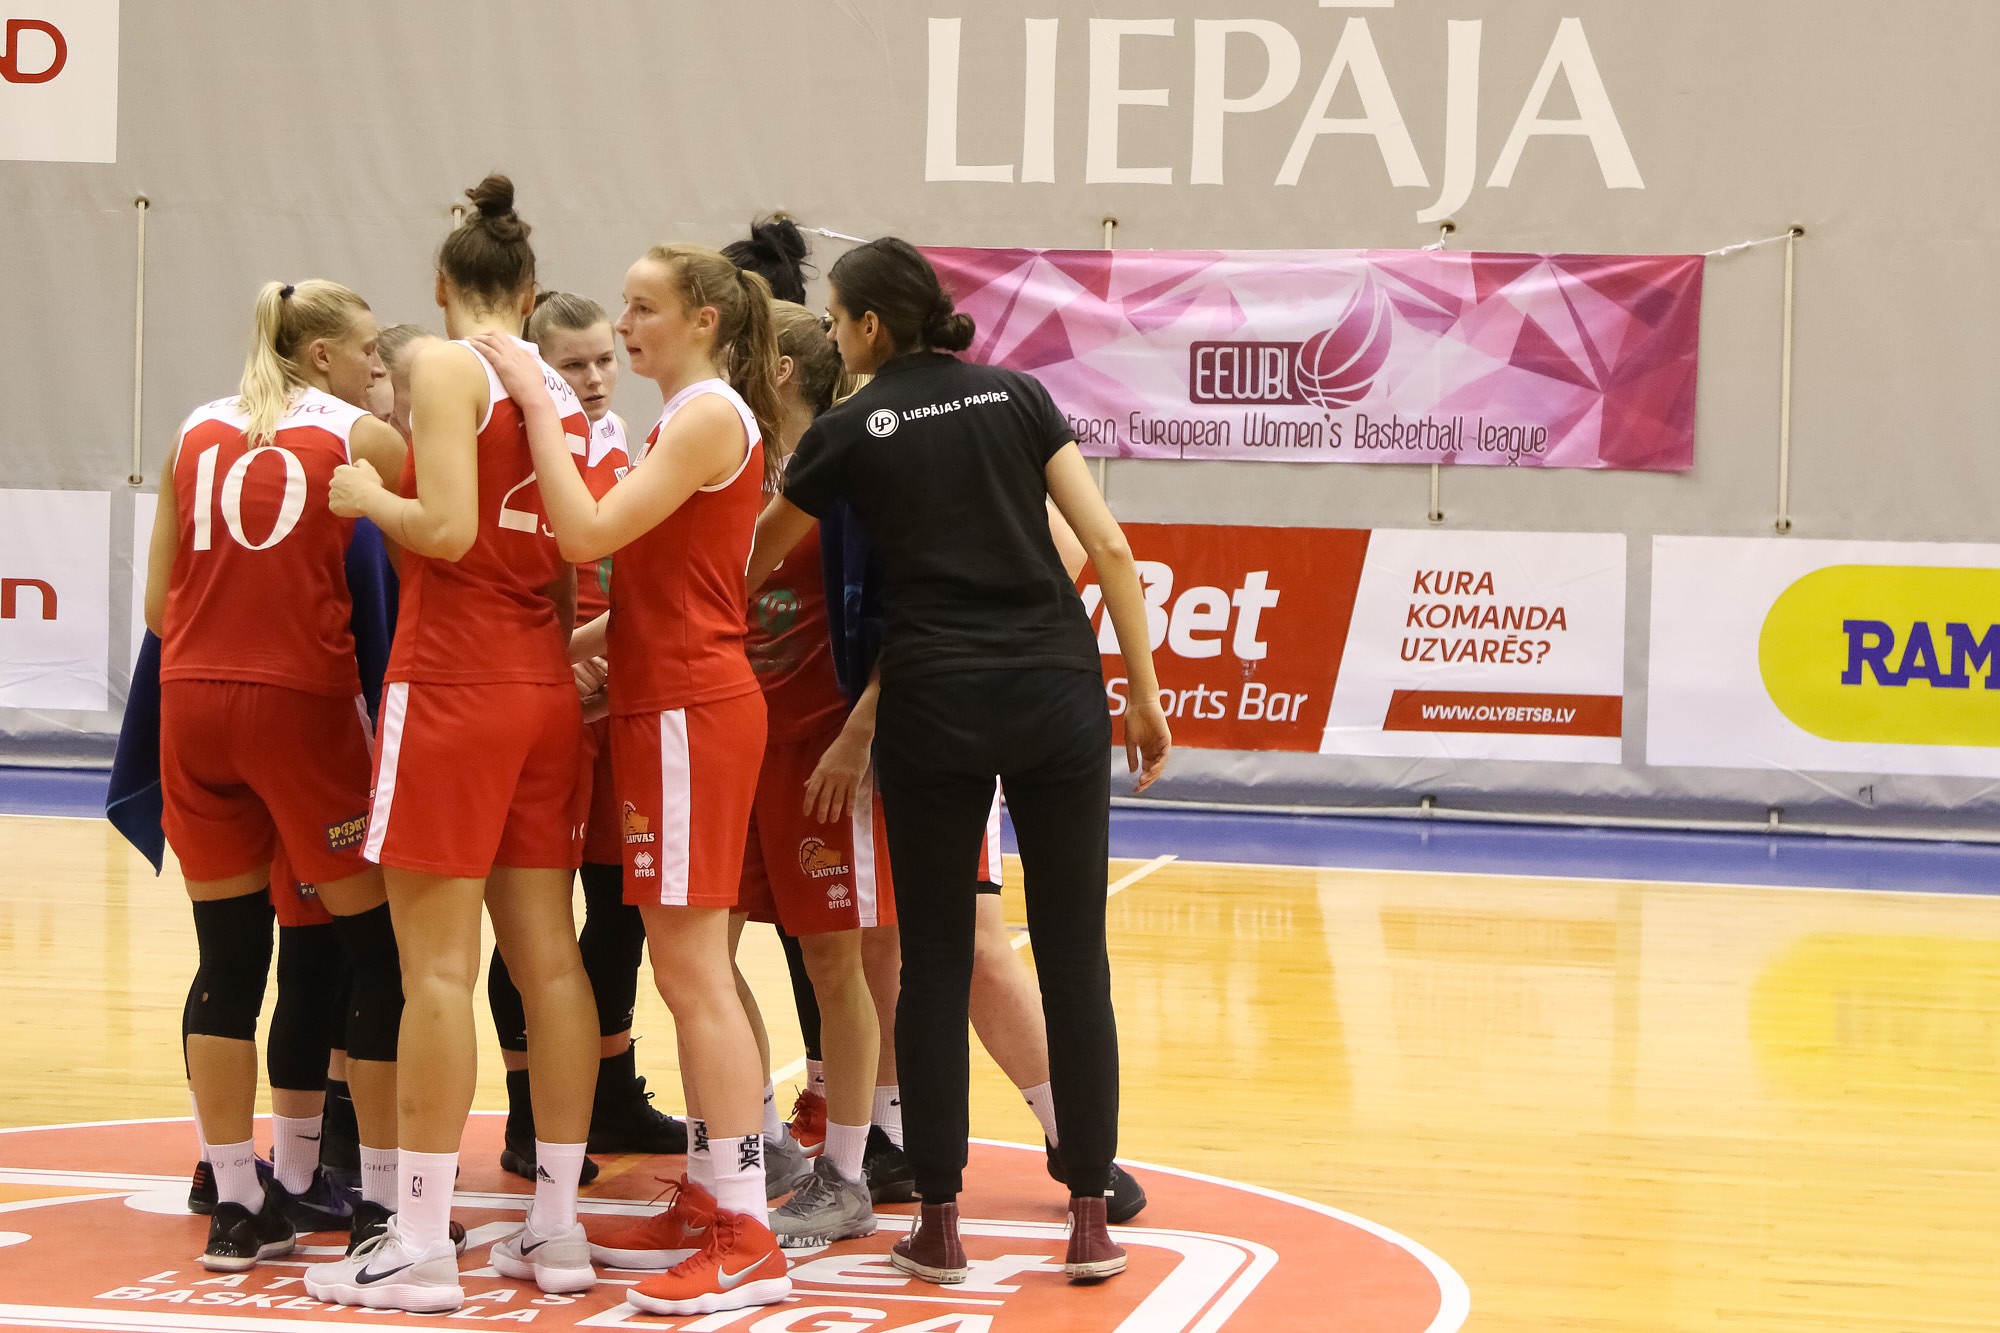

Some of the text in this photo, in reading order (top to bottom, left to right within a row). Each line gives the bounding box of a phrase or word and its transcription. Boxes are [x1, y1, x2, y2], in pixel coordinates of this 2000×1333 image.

[0, 19, 68, 84] D
[925, 0, 1645, 223] LIEPĀJA
[902, 391, 1009, 421] LIEPĀJAS PAPĪRS
[1067, 413, 1116, 444] tern
[1244, 412, 1342, 448] Women's
[1354, 413, 1464, 451] Basketball
[193, 443, 308, 551] 10
[1412, 569, 1495, 596] KURA
[1406, 603, 1568, 631] KOMANDA
[1400, 635, 1552, 665] UZVARĒS?
[1841, 619, 2000, 690] RAM
[1106, 677, 1309, 722] Sorts Bar
[1421, 704, 1576, 724] WWW.OLYBETSB.LV
[626, 832, 655, 844] LAUVAS
[811, 864, 850, 879] LAUVAS
[827, 898, 852, 910] errea
